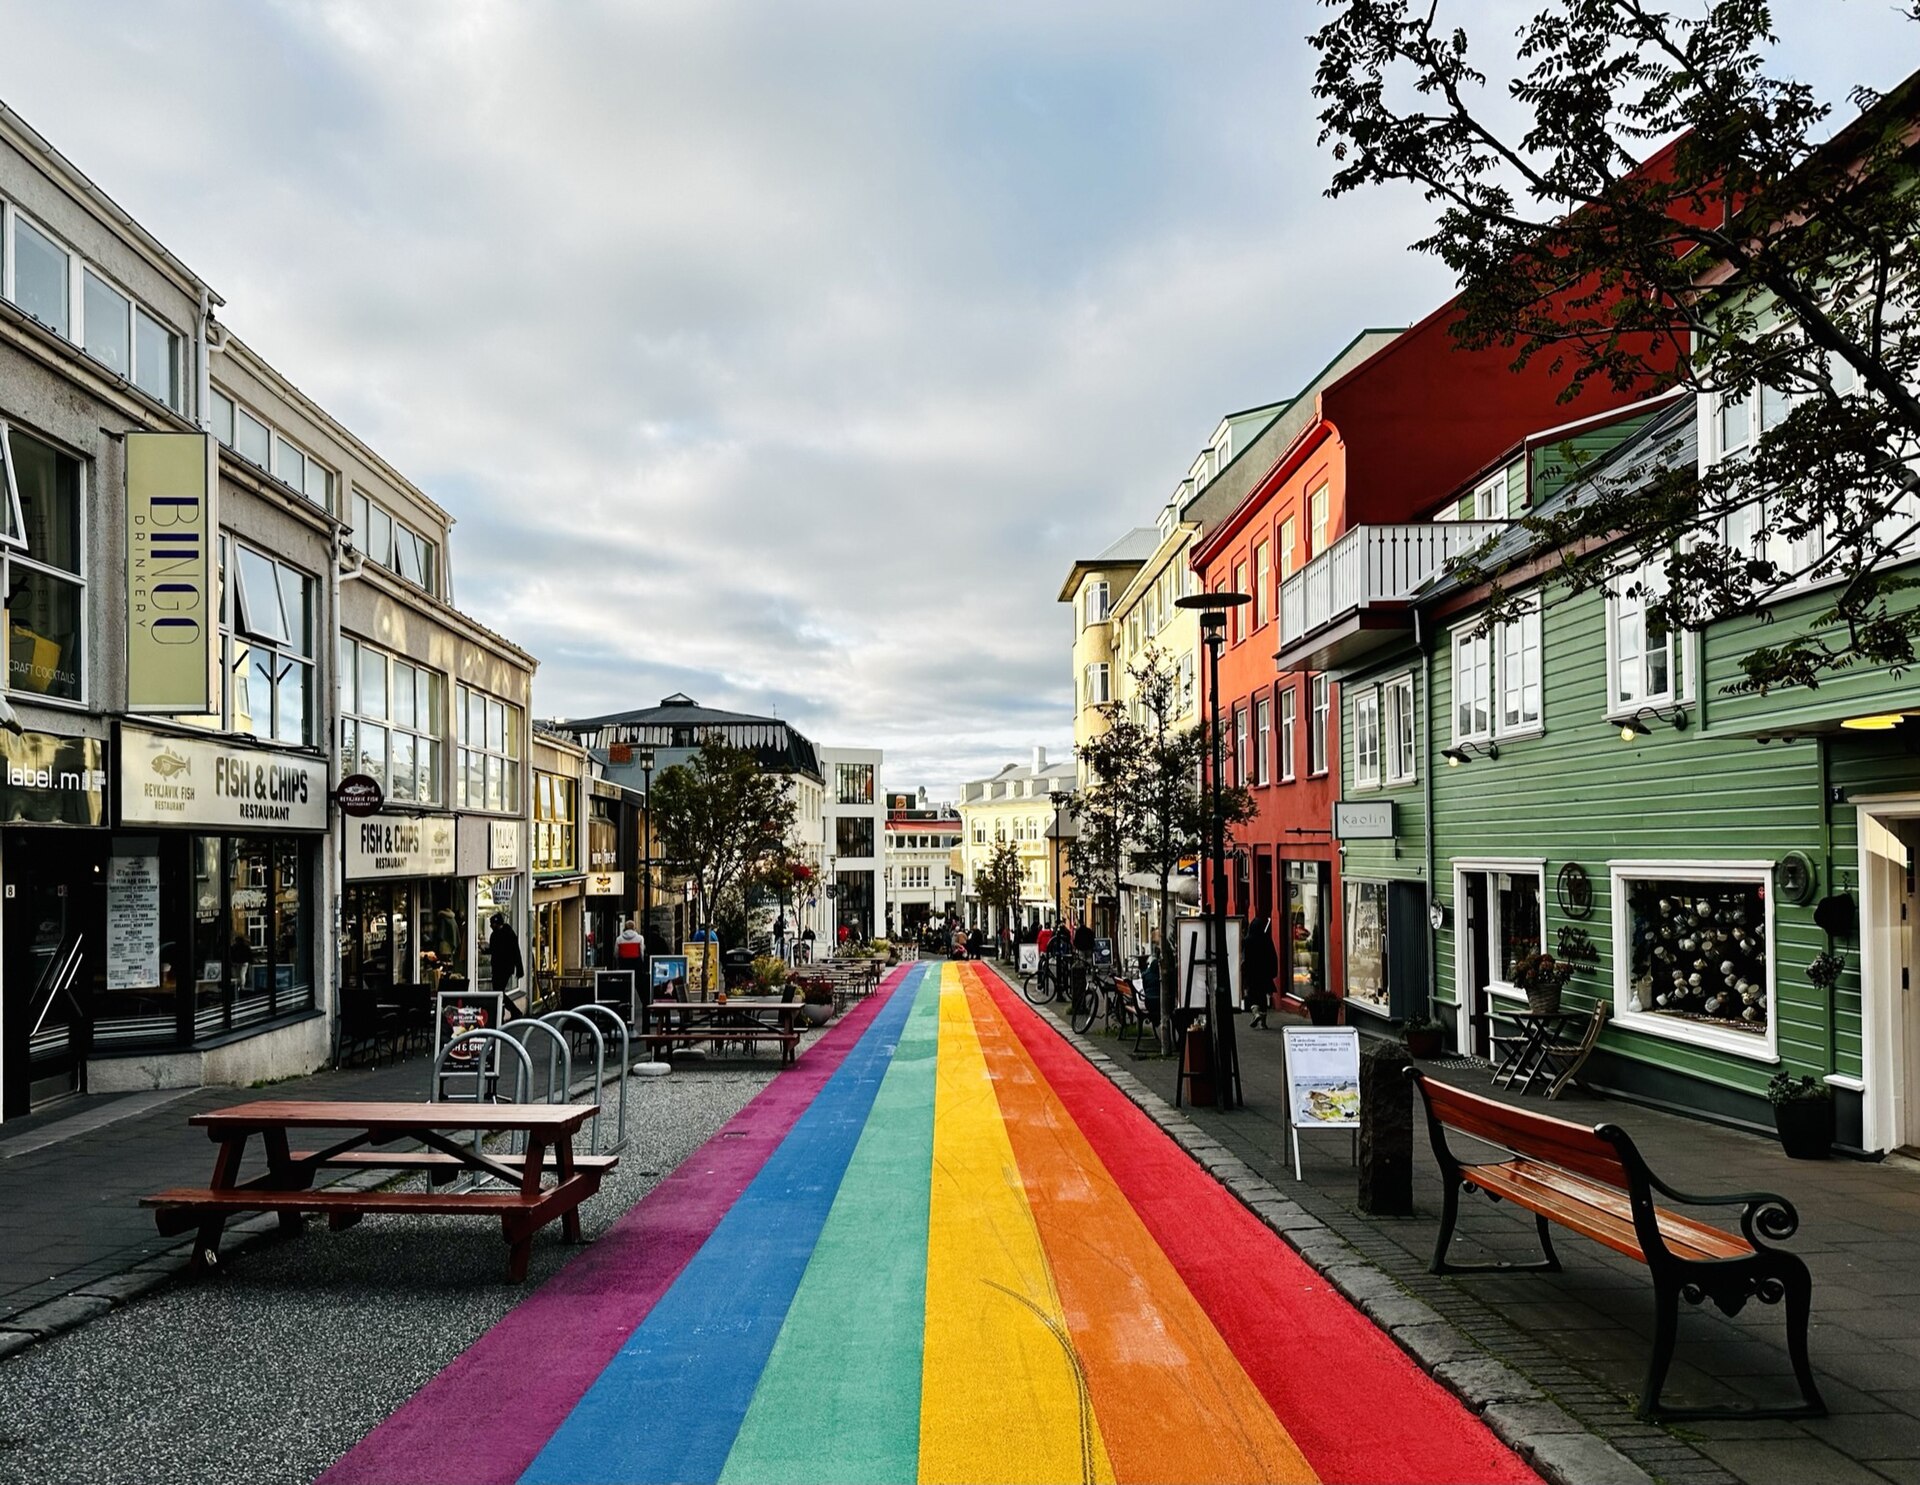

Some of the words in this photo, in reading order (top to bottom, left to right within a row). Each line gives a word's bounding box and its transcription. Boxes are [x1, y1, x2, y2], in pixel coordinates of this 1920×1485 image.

[135, 515, 146, 628] DRINKERY
[150, 497, 200, 645] BINGO
[9, 659, 33, 675] CRAFT
[35, 665, 76, 685] COCKTAILS
[7, 760, 79, 790] label.m
[215, 756, 249, 799] FISH
[254, 764, 267, 801] &
[269, 765, 308, 804] CHIPS
[144, 783, 179, 798] REYKJAVIK
[181, 786, 195, 801] FISH
[1834, 788, 1840, 801] 5
[154, 800, 186, 812] RESTAURANT
[240, 803, 290, 822] RESTAURANT
[1342, 814, 1387, 825] Kaolin
[361, 823, 383, 855] FISH
[385, 825, 393, 854] &
[394, 824, 419, 854] CHIPS
[375, 856, 408, 869] RESTAURANT
[7, 886, 14, 897] 8
